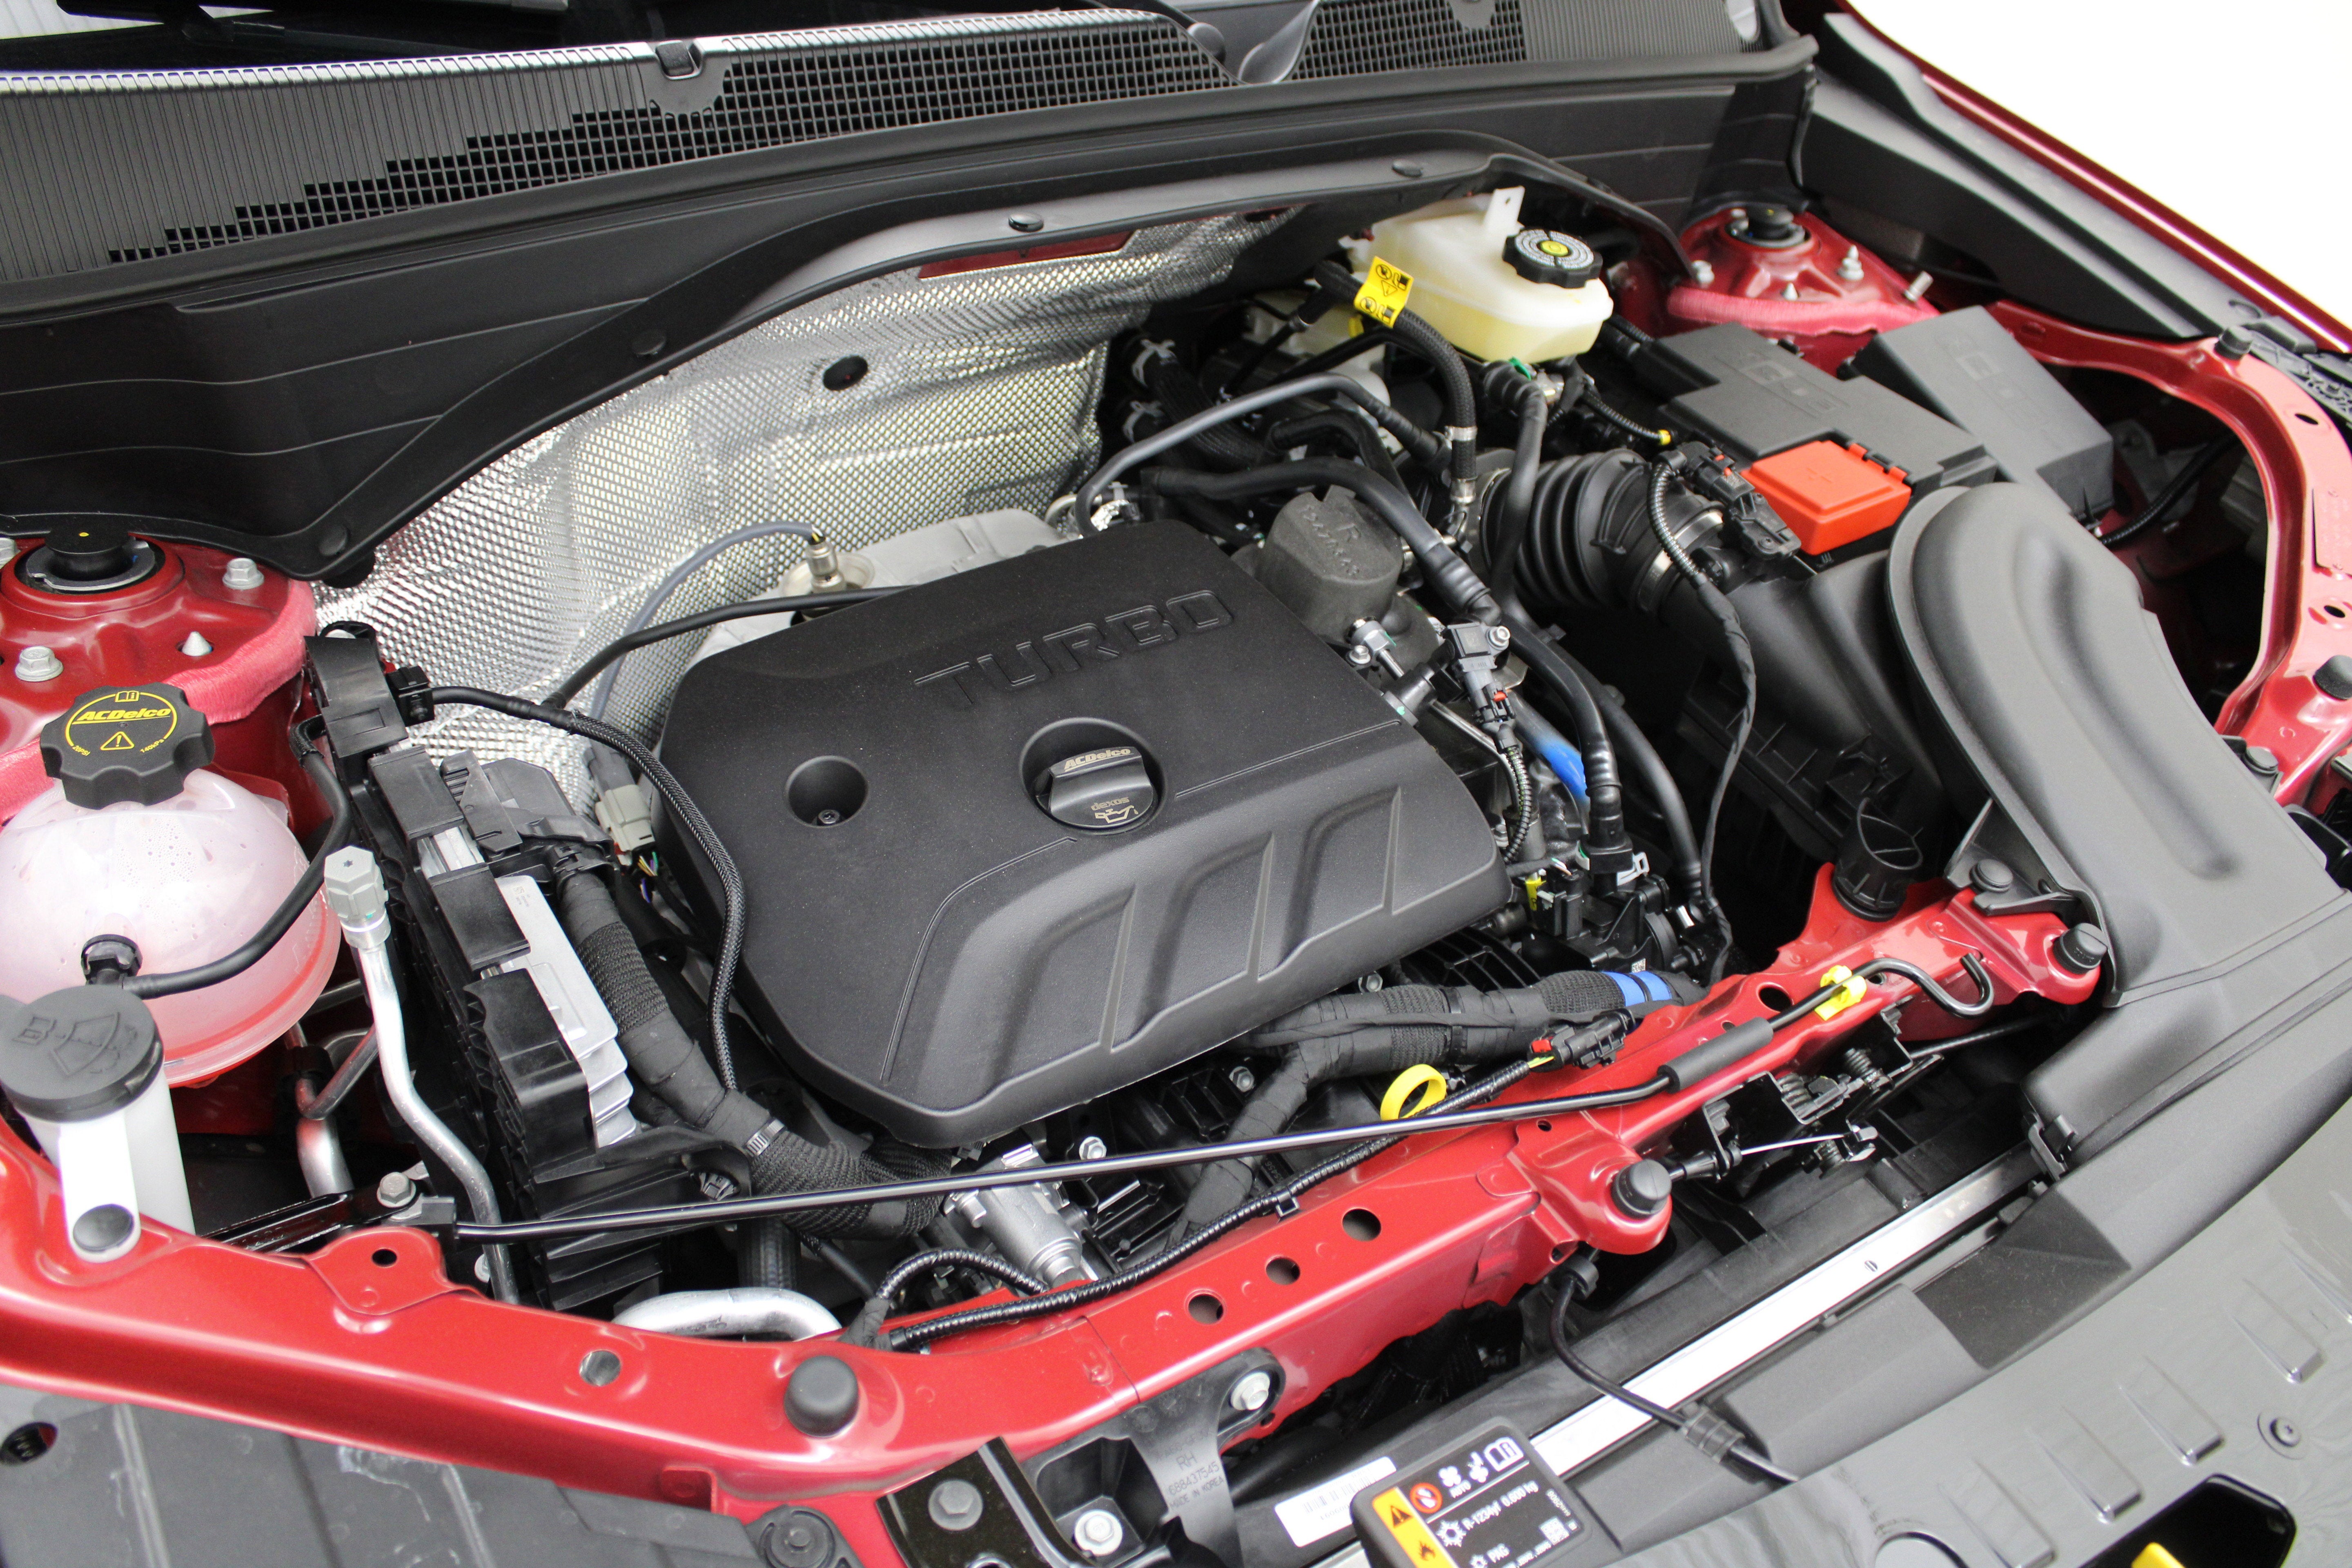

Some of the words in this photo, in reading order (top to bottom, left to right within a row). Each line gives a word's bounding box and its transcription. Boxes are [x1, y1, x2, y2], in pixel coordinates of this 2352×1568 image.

[914, 590, 1235, 706] TURBO
[76, 708, 172, 721] ACDelco
[72, 745, 91, 756] 20PSI
[140, 739, 165, 753] 140kPa
[1064, 748, 1131, 770] ACDelco
[1091, 797, 1130, 811] dexos
[1176, 1452, 1197, 1471] RH
[1168, 1461, 1219, 1495] 688437545
[1192, 1488, 1201, 1499] IN
[1202, 1476, 1224, 1494] KOREA
[1449, 1479, 1471, 1499] AUTO
[1461, 1500, 1501, 1530] R-1234yf
[1500, 1483, 1527, 1508] 0.600
[1523, 1480, 1539, 1498] kg
[1486, 1543, 1510, 1564] PAG
